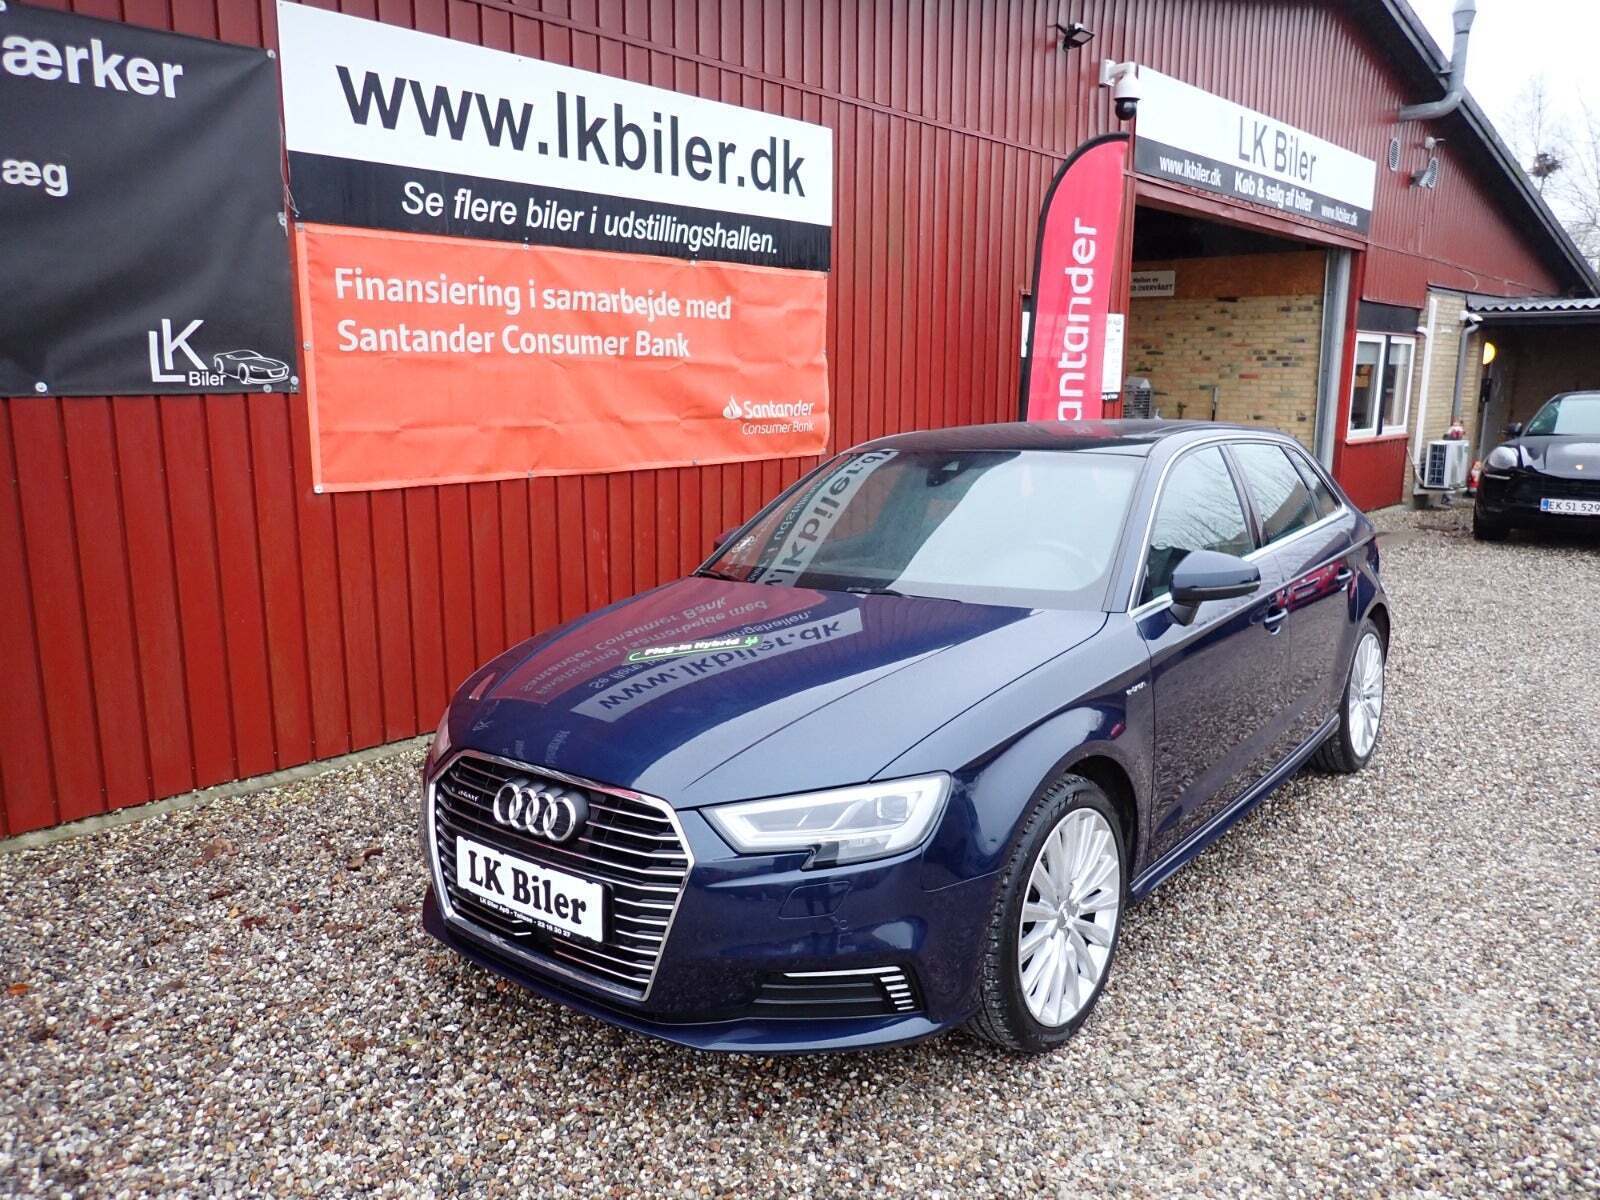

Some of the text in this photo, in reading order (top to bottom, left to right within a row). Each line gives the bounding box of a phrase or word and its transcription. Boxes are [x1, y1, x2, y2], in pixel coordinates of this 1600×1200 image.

[336, 65, 806, 197] www.lkbiler.dk
[1238, 116, 1317, 183] LK Biler
[1159, 156, 1221, 187] www.lkbiler.dk
[1234, 171, 1313, 213] Køb & salg af biler
[402, 181, 778, 253] Se flere biler i udstillingshallen.
[335, 267, 731, 322] Finansiering i samarbejde med
[148, 319, 208, 382] LK
[337, 319, 690, 357] Santander Consumer Bank
[189, 371, 226, 386] Biler
[742, 421, 815, 435] Consumer Bank
[743, 400, 815, 418] Santander
[1566, 502, 1576, 511] 51
[468, 850, 586, 925] LK Biler
